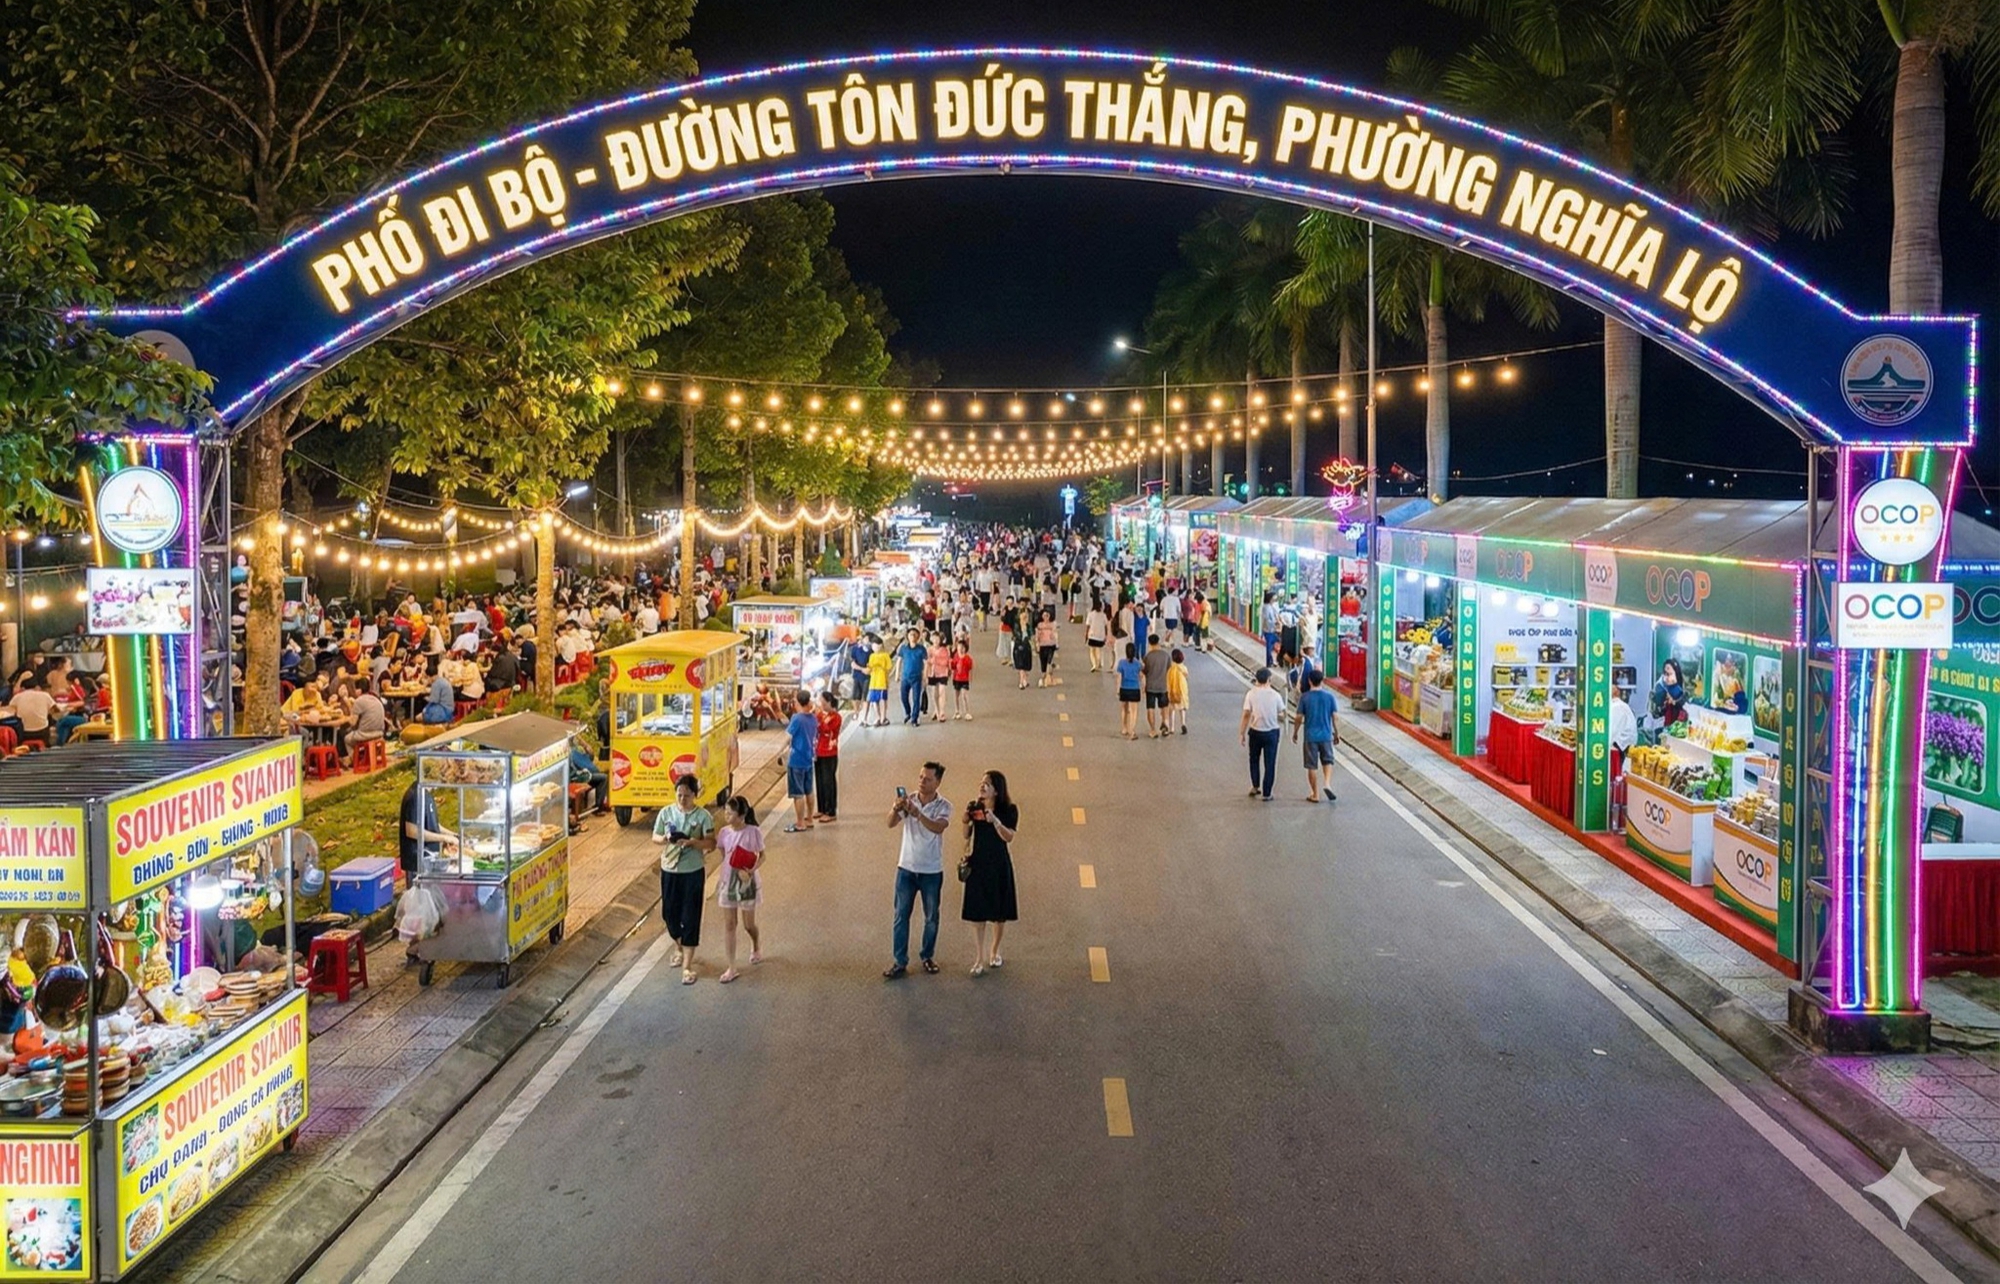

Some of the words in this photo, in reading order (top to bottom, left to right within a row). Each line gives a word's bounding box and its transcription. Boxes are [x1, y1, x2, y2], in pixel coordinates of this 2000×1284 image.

[311, 194, 425, 313] PHỐ
[424, 186, 489, 256] ĐI
[488, 144, 567, 229] BỘ
[605, 97, 796, 191] ĐƯỜNG
[807, 73, 917, 149] TÔN
[934, 63, 1045, 139] ĐỨC
[1064, 62, 1258, 164] THẮNG,
[1275, 105, 1498, 215] PHƯỜNG
[1500, 170, 1664, 289] NGHĨA
[1662, 248, 1742, 335] LỘ
[1860, 504, 1936, 524] OCOP
[1645, 564, 1711, 613] OCOP
[1844, 593, 1945, 620] OCOP
[116, 781, 226, 856] SOUVENIR
[1644, 800, 1672, 827] OCOP
[35, 821, 76, 857] KÁN
[1736, 849, 1773, 883] OCOP
[163, 1053, 247, 1141] SOUVENIR
